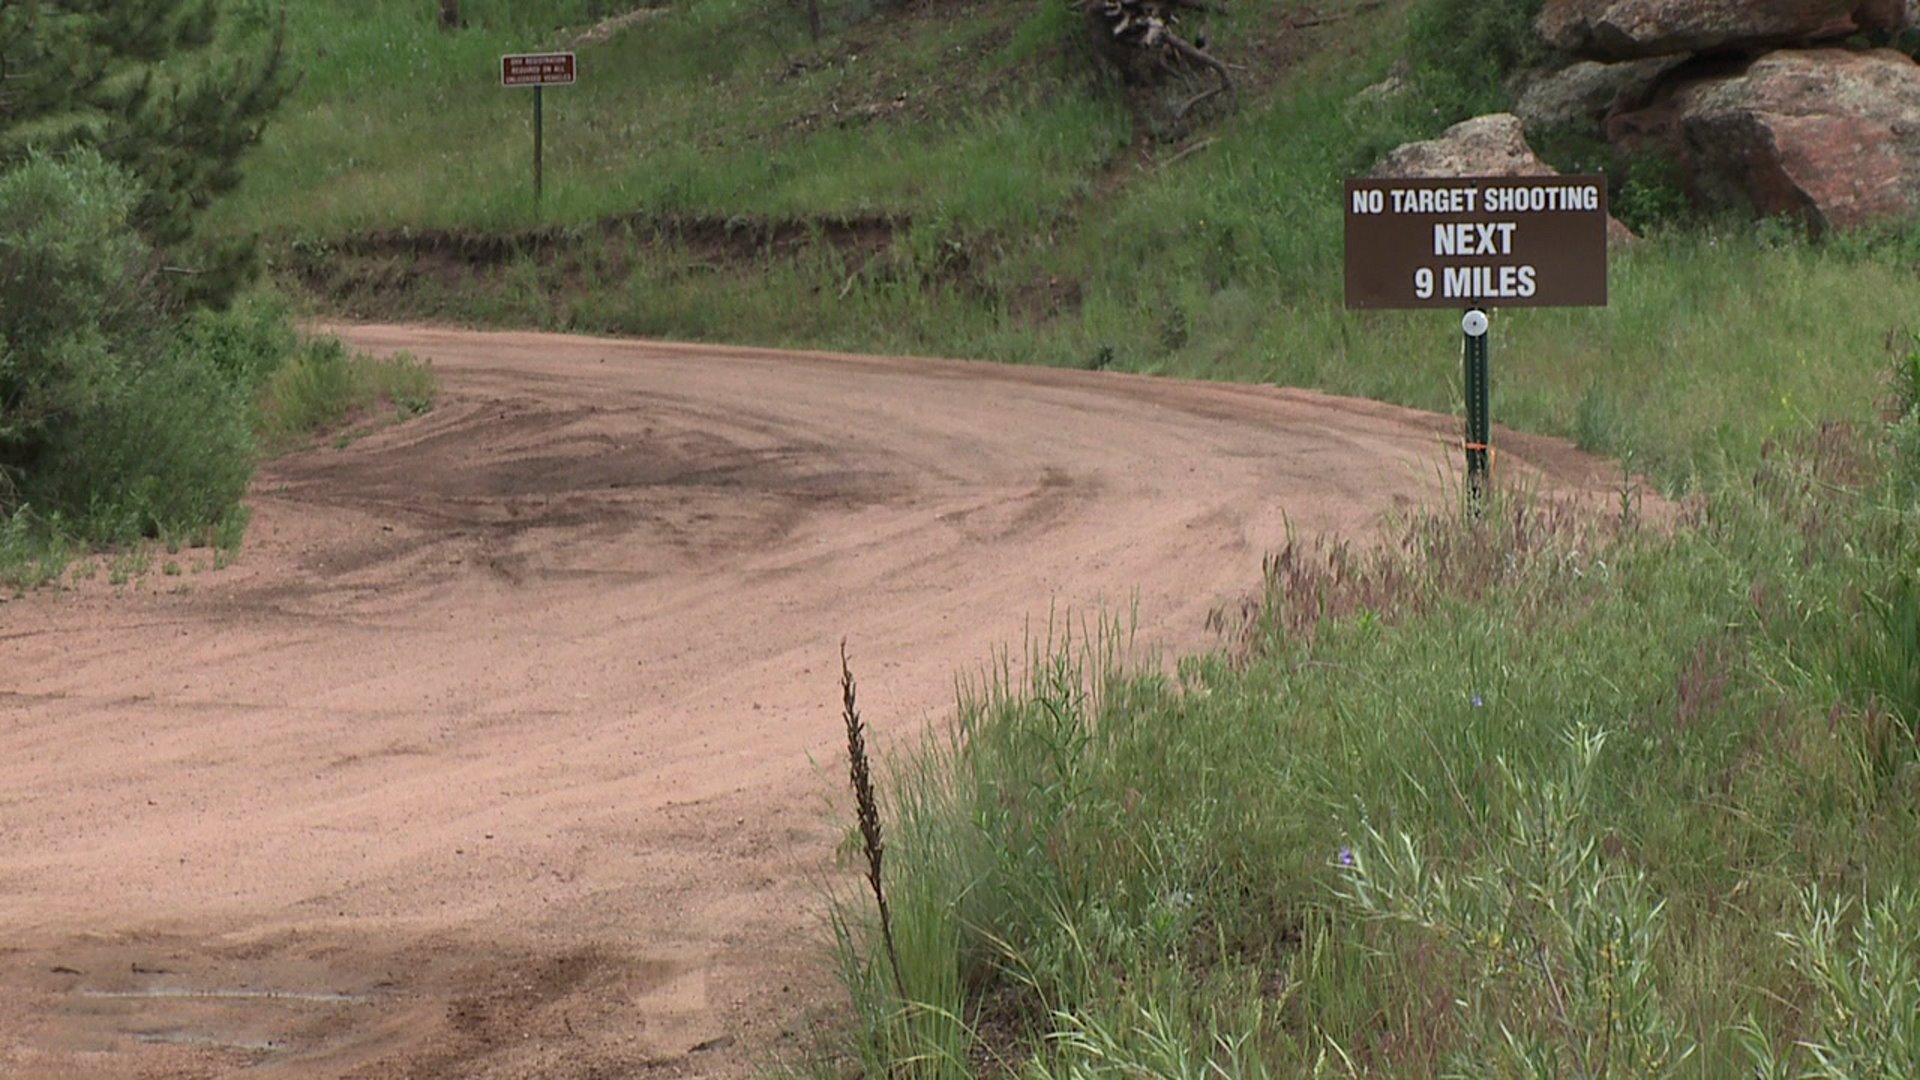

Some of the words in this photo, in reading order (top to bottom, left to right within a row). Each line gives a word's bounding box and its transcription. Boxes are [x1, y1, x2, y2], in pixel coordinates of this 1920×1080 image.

[543, 66, 552, 74] ON
[554, 65, 565, 73] ALL
[1352, 189, 1384, 214] NO
[1390, 188, 1479, 213] TARGET
[1484, 185, 1599, 212] SHOOTING
[1433, 222, 1517, 256] NEXT
[1414, 267, 1434, 299] 9
[1443, 265, 1536, 298] MILES
